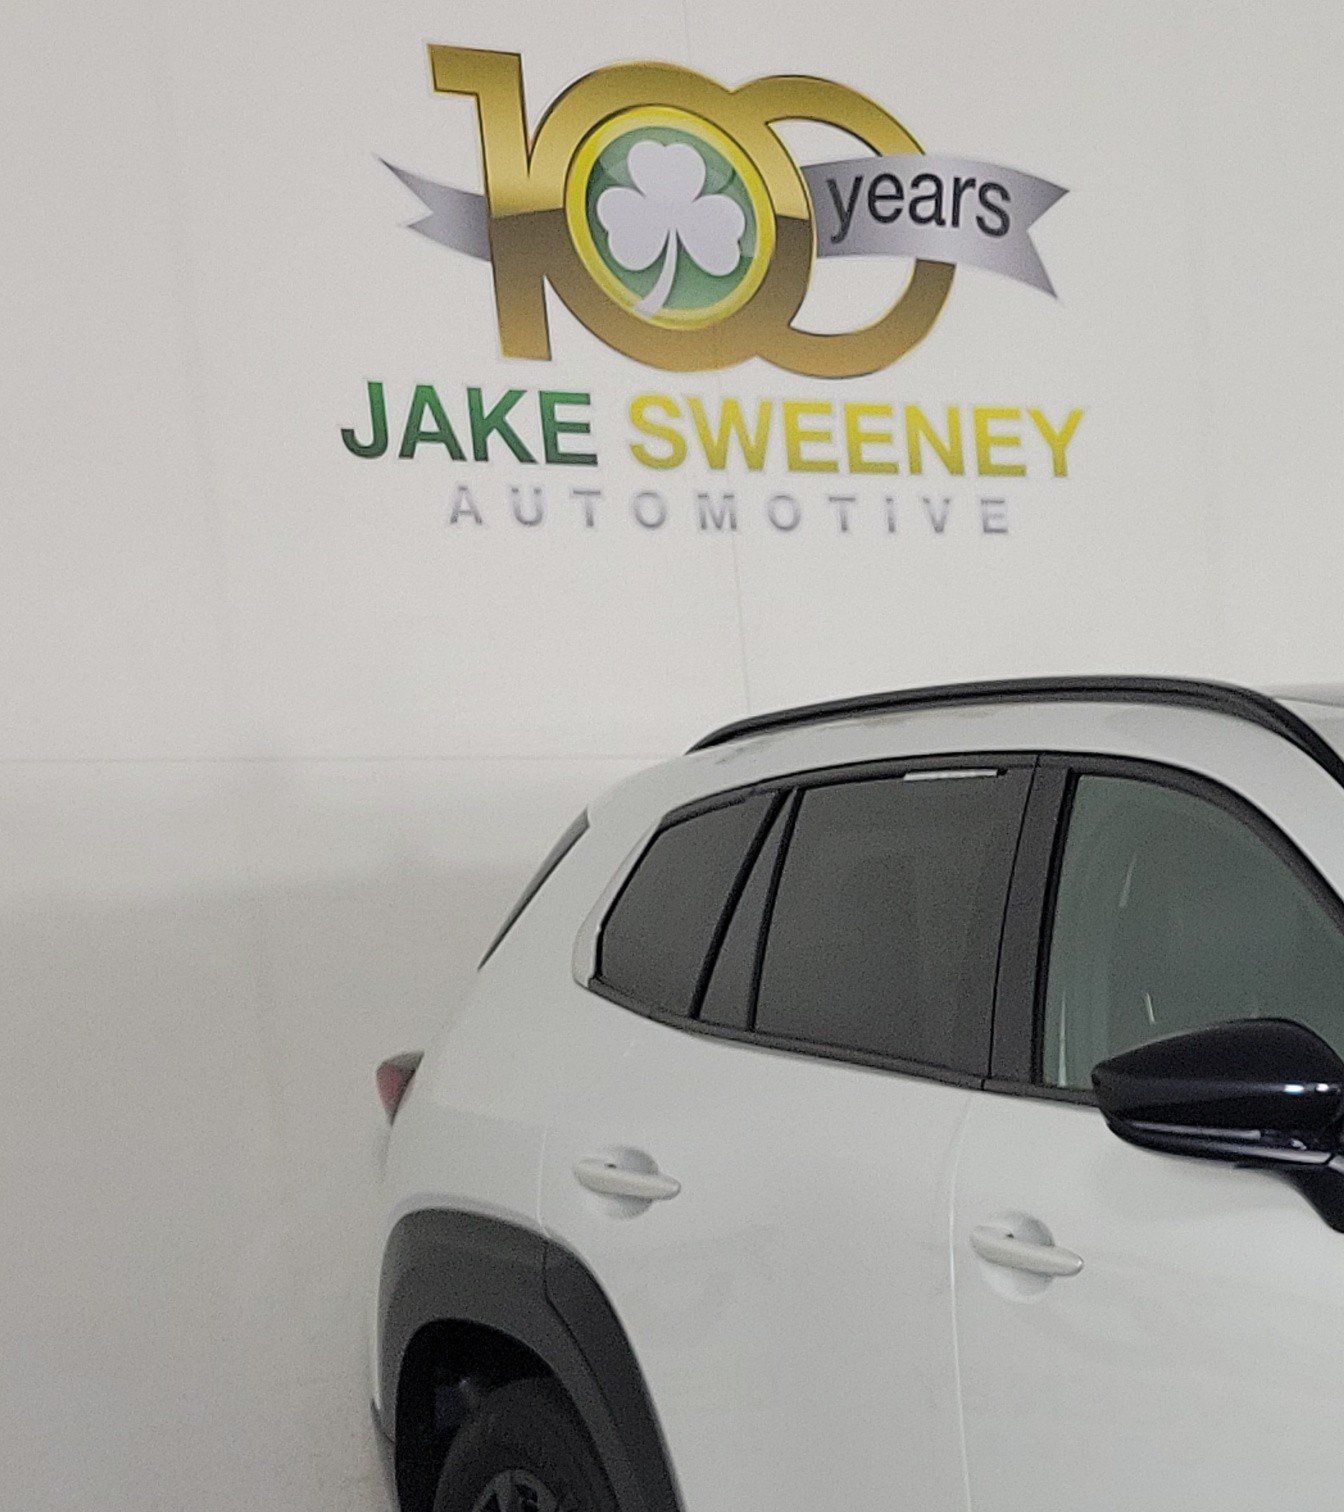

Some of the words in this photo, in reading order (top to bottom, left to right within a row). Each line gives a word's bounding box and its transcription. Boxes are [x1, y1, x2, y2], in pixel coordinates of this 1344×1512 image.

[427, 44, 956, 379] 100
[826, 172, 1011, 245] years
[340, 381, 597, 465] JAKE
[629, 394, 1083, 477] SWEENEY
[449, 485, 1008, 535] AUTOMOTIVE
